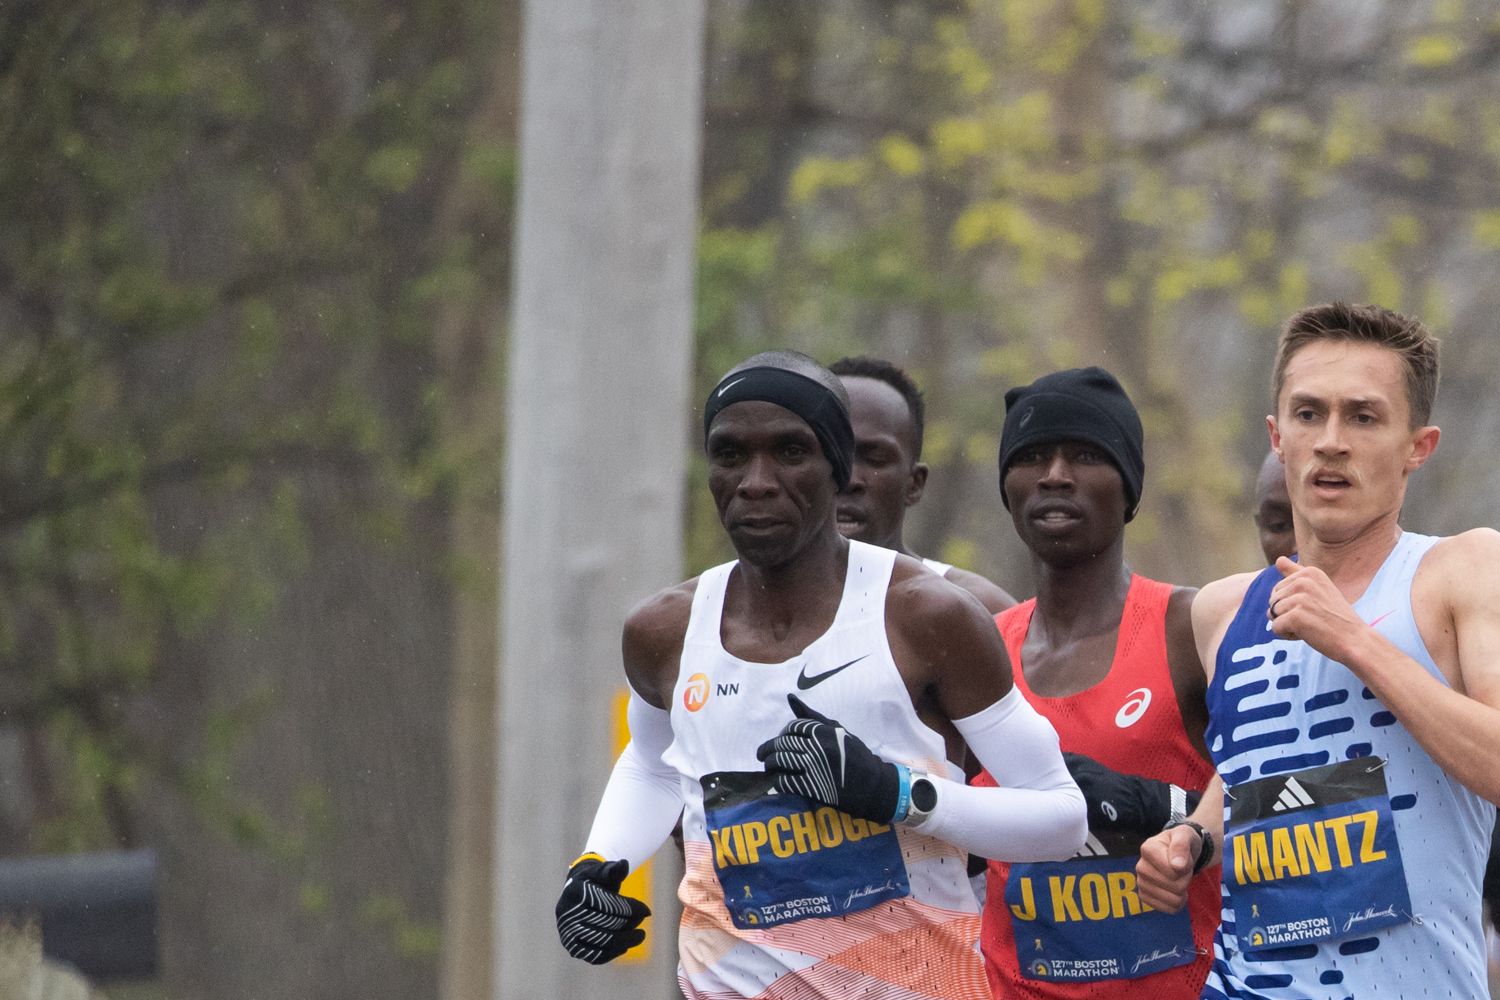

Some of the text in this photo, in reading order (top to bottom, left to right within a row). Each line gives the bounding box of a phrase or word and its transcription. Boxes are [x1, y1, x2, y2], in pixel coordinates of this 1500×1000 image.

[717, 683, 739, 696] NN
[711, 806, 890, 869] KIPCHOG
[1233, 810, 1387, 885] MANTZ
[786, 896, 829, 909] BOSTON
[1010, 871, 1155, 923] J KOR
[764, 904, 832, 924] MARATHON
[1287, 917, 1329, 931] BOSTON
[1268, 927, 1332, 944] MARATHON
[1074, 958, 1117, 968] BOSTON
[1053, 967, 1120, 977] MARATHON
